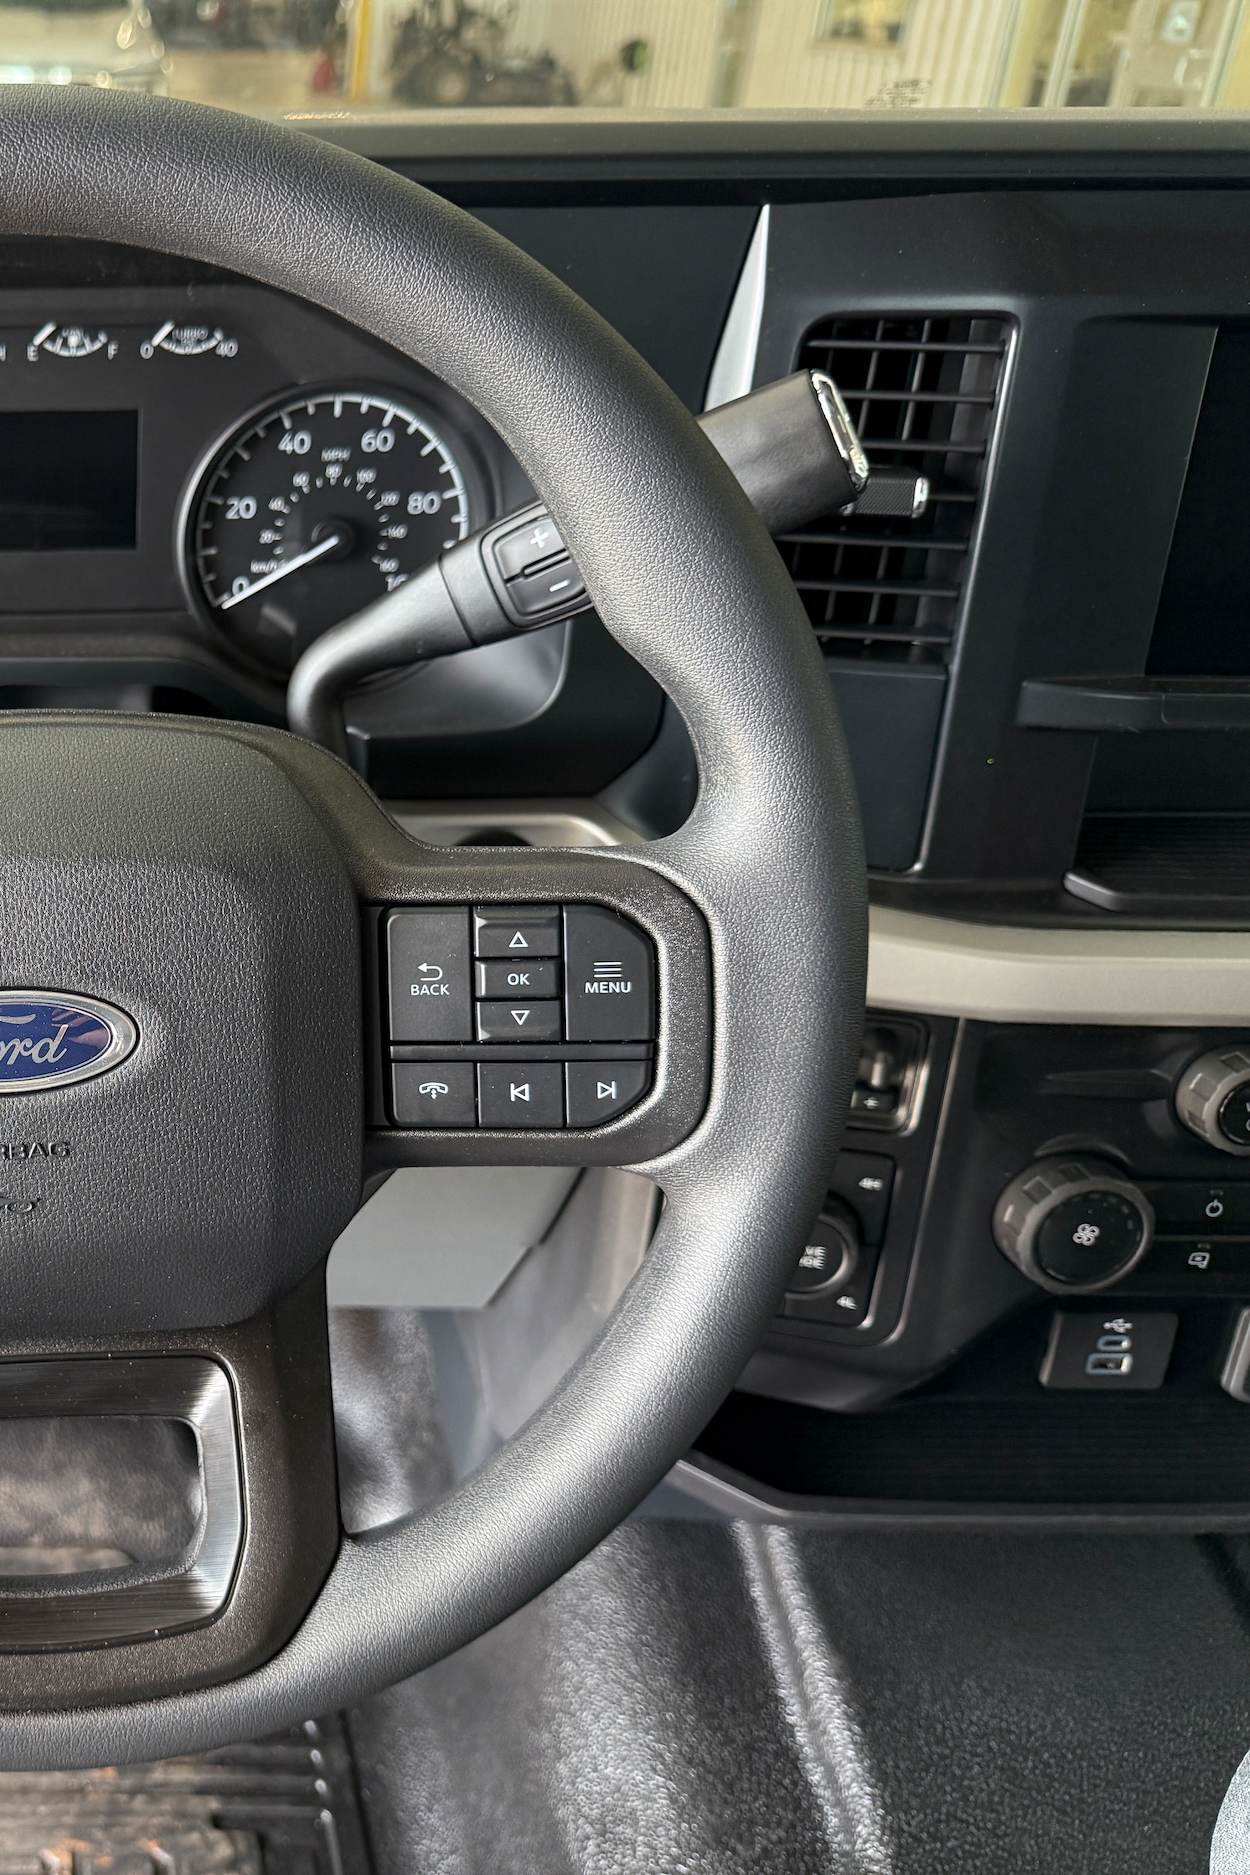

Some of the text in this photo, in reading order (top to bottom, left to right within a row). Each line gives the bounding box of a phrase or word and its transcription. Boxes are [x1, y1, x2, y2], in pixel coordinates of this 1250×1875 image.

[27, 344, 39, 362] E
[107, 340, 118, 360] F
[215, 337, 238, 358] 40
[278, 429, 312, 456] 40
[360, 428, 396, 454] 60
[225, 495, 258, 520] 20
[407, 491, 442, 516] 80
[507, 973, 530, 986] OK
[584, 981, 632, 994] MENU
[410, 984, 450, 996] BACK
